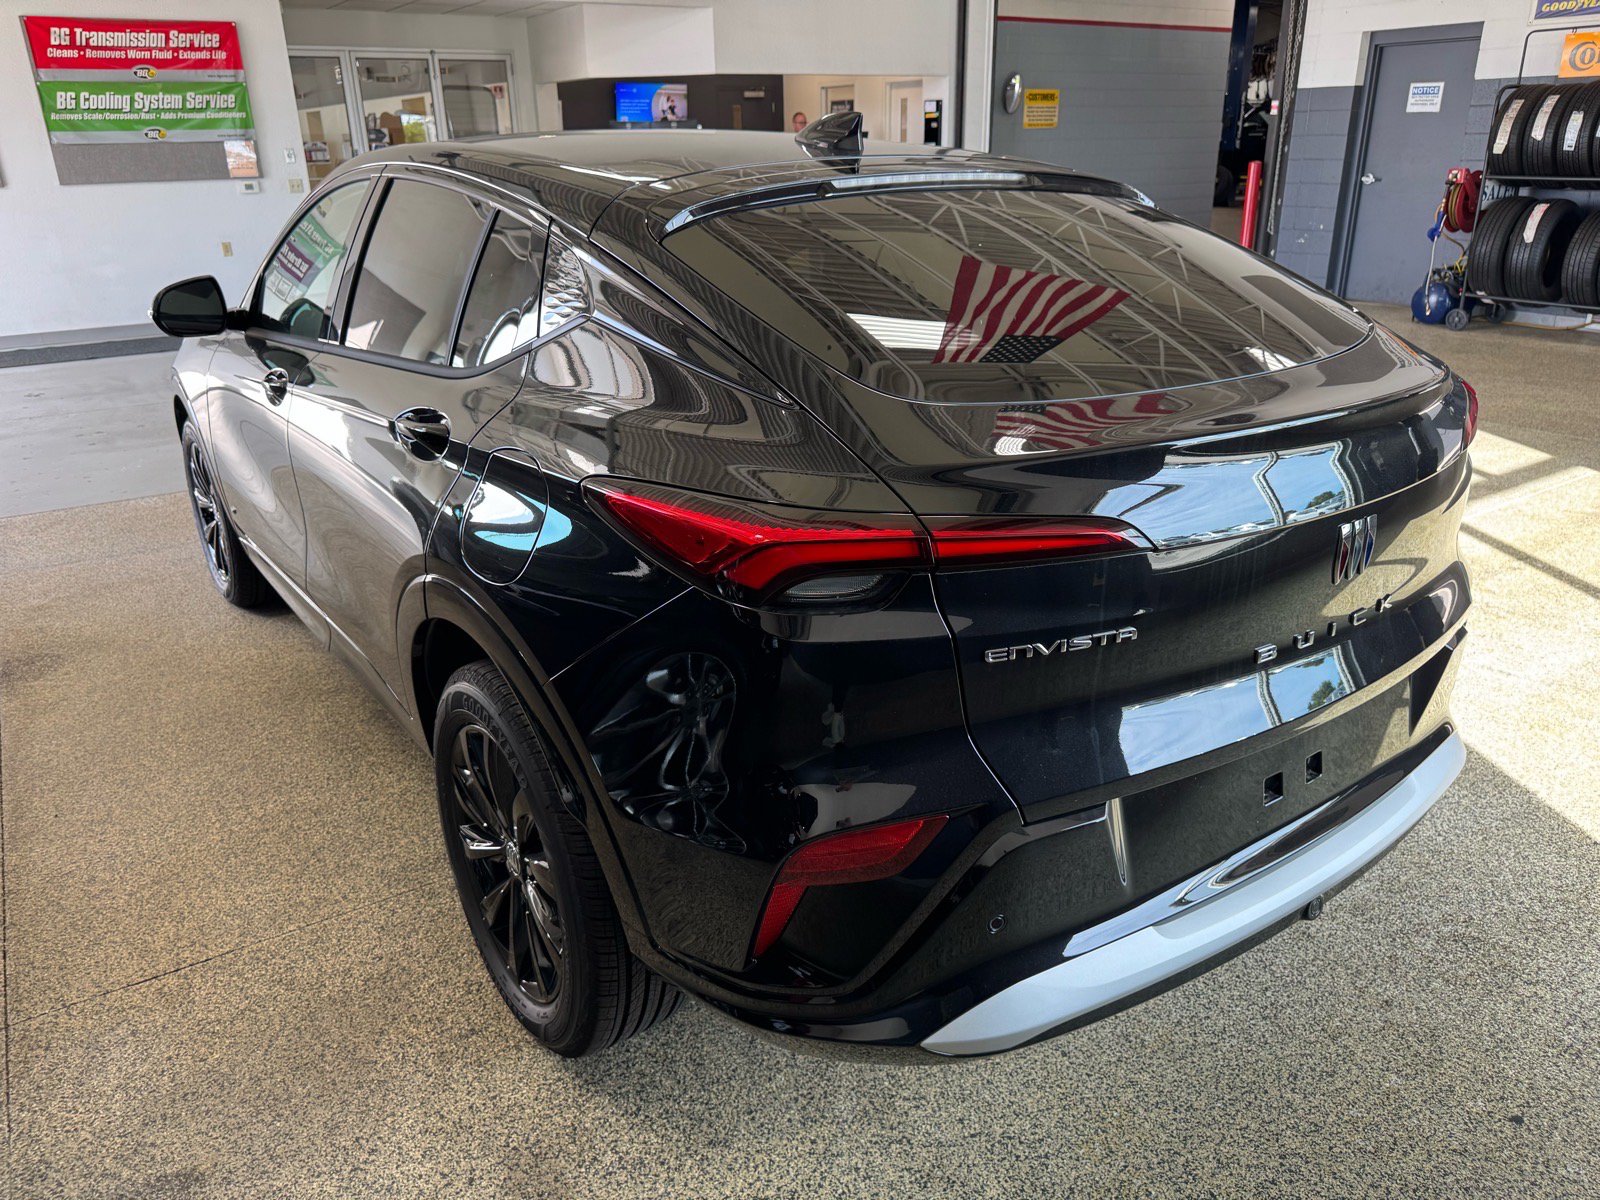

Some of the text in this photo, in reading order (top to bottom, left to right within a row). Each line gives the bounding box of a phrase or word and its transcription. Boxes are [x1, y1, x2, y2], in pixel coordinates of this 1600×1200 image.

[1541, 0, 1600, 12] GOODYE
[50, 27, 220, 48] BG Transmission Service
[47, 48, 227, 60] Cleans Removes Worn Fluid Extends Life
[1569, 41, 1600, 71] Co
[1412, 86, 1440, 95] NOTICE
[56, 91, 236, 112] BG Cooling System Service
[51, 112, 82, 120] Removes
[160, 112, 177, 120] Adds
[1254, 593, 1393, 664] BUICK
[984, 626, 1138, 663] ENVISTA
